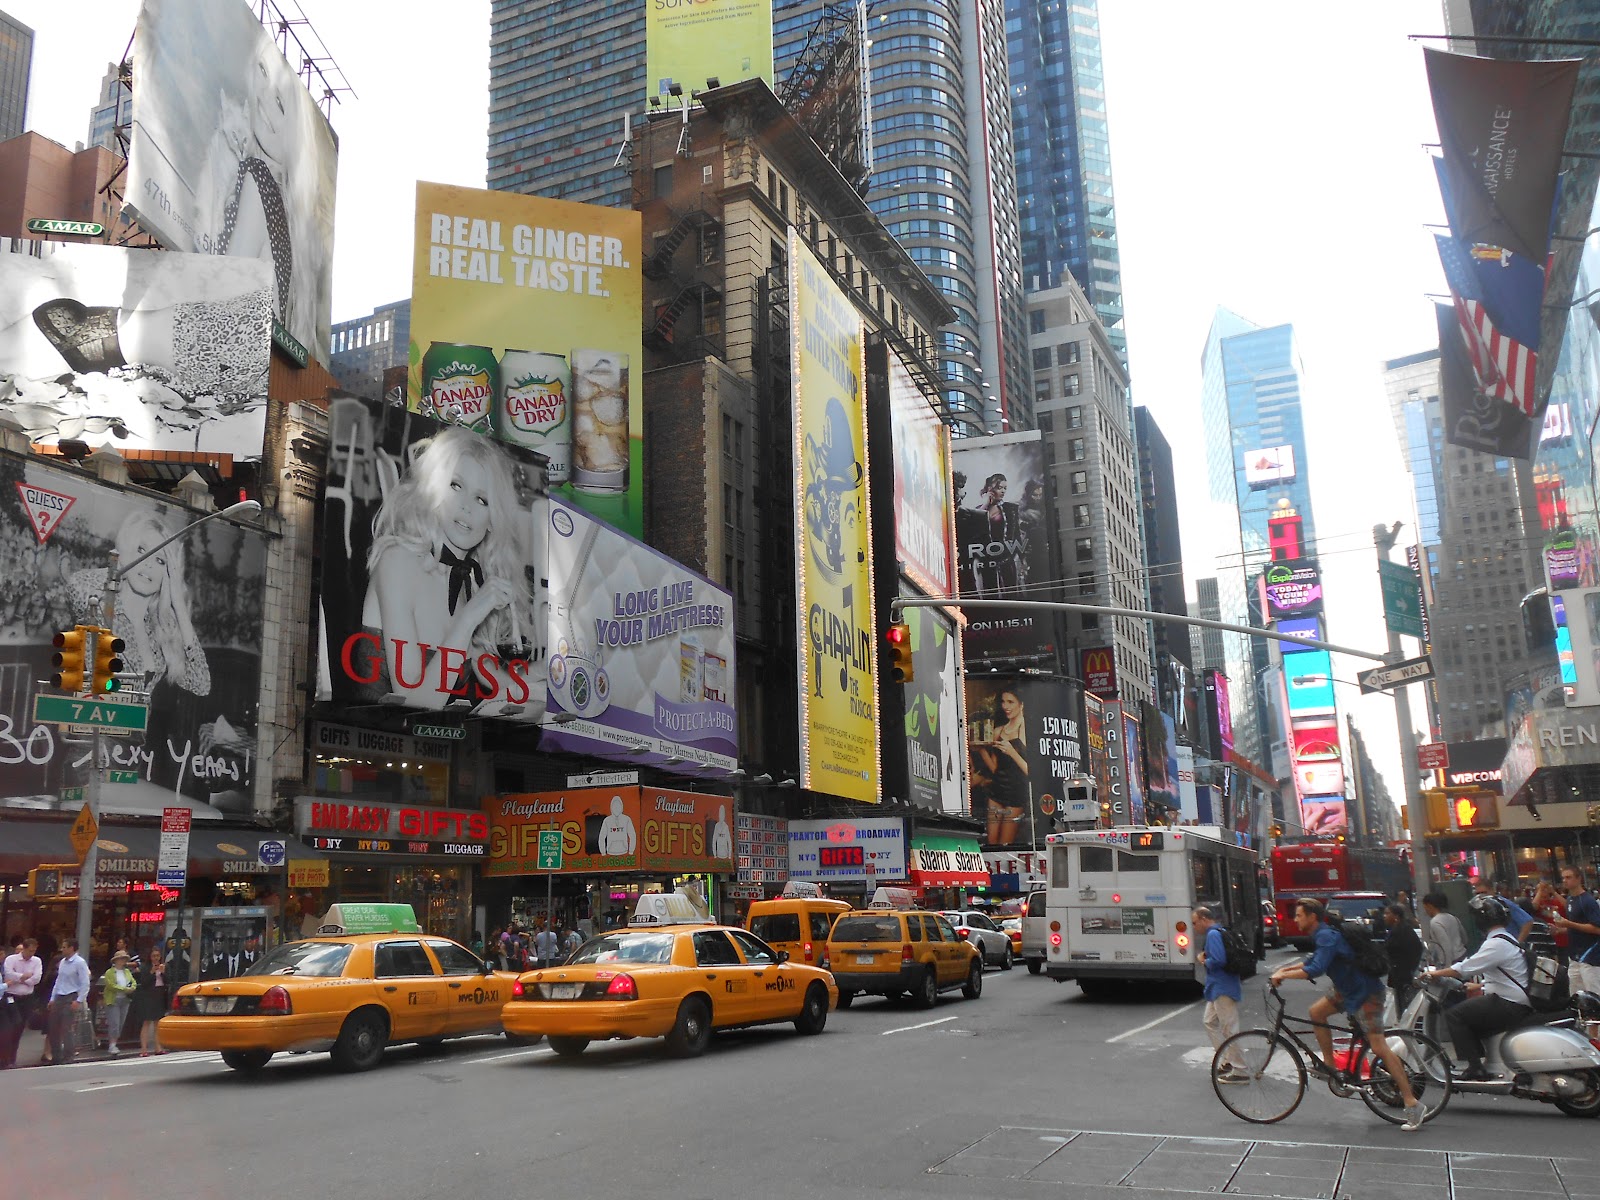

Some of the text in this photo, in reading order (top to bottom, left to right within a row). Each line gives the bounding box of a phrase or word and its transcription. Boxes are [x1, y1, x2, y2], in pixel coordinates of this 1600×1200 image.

[32, 220, 95, 234] LAMAR
[430, 212, 630, 269] REAL GINGER.
[429, 245, 610, 297] REAL TASTE.
[272, 325, 306, 363] LAMAR
[831, 347, 858, 402] TRAMP
[431, 383, 493, 409] CANADA
[506, 392, 567, 417] CANADA
[524, 407, 557, 425] DRY
[26, 489, 64, 511] GUESS
[1272, 508, 1297, 519] 2012
[968, 537, 1029, 560] ROW
[615, 580, 694, 618] LONG LIVE
[1277, 590, 1309, 600] YOUNG
[595, 604, 725, 647] YOUR MATTRESS!
[971, 617, 1034, 631] ON 11.15.11
[341, 631, 530, 705] GUESS
[1088, 671, 1109, 679] OPEN
[1369, 664, 1425, 686] ONE WAY
[849, 676, 859, 698] THE
[1091, 677, 1108, 687] 24
[71, 703, 84, 720] 7
[416, 726, 464, 739] LAMAR
[1042, 716, 1078, 739] 150 YEARS
[320, 726, 449, 760] GIFTS LUGGAGE T-SHIRT
[660, 740, 673, 755] Every
[1039, 737, 1051, 756] OF
[1105, 711, 1123, 814] PALACE
[115, 772, 122, 782] 7
[500, 797, 565, 820] Playland
[655, 795, 695, 816] Playland
[311, 802, 489, 840] EMBASSY GIFTS
[738, 818, 786, 830] NYC GIFT NYC GIFT
[313, 837, 342, 849] I NY
[489, 820, 582, 859] GIFS
[643, 819, 705, 857] GIFTS
[738, 830, 786, 843] GIFT NYC GIFT NYC
[788, 831, 828, 841] PHANTOM
[856, 828, 901, 839] BROADWAY
[1105, 836, 1129, 844] 6648
[263, 844, 270, 853] P
[444, 843, 484, 855] LUGGAGE
[738, 844, 786, 855] NYC GIFT NYC GIFT
[798, 854, 817, 862] NYC
[821, 848, 863, 866] GIFTS
[876, 851, 891, 860] NY
[919, 843, 984, 872] sbarro sbarro
[98, 858, 155, 873] SMILER'S
[598, 855, 636, 868] LUGGAGE
[739, 858, 749, 867] GIFT
[752, 858, 762, 867] NYC
[765, 858, 775, 868] GIFT
[778, 859, 787, 868] NYC
[307, 873, 326, 883] PHOTO
[739, 871, 787, 881] NYC GIFT NYC GIFT
